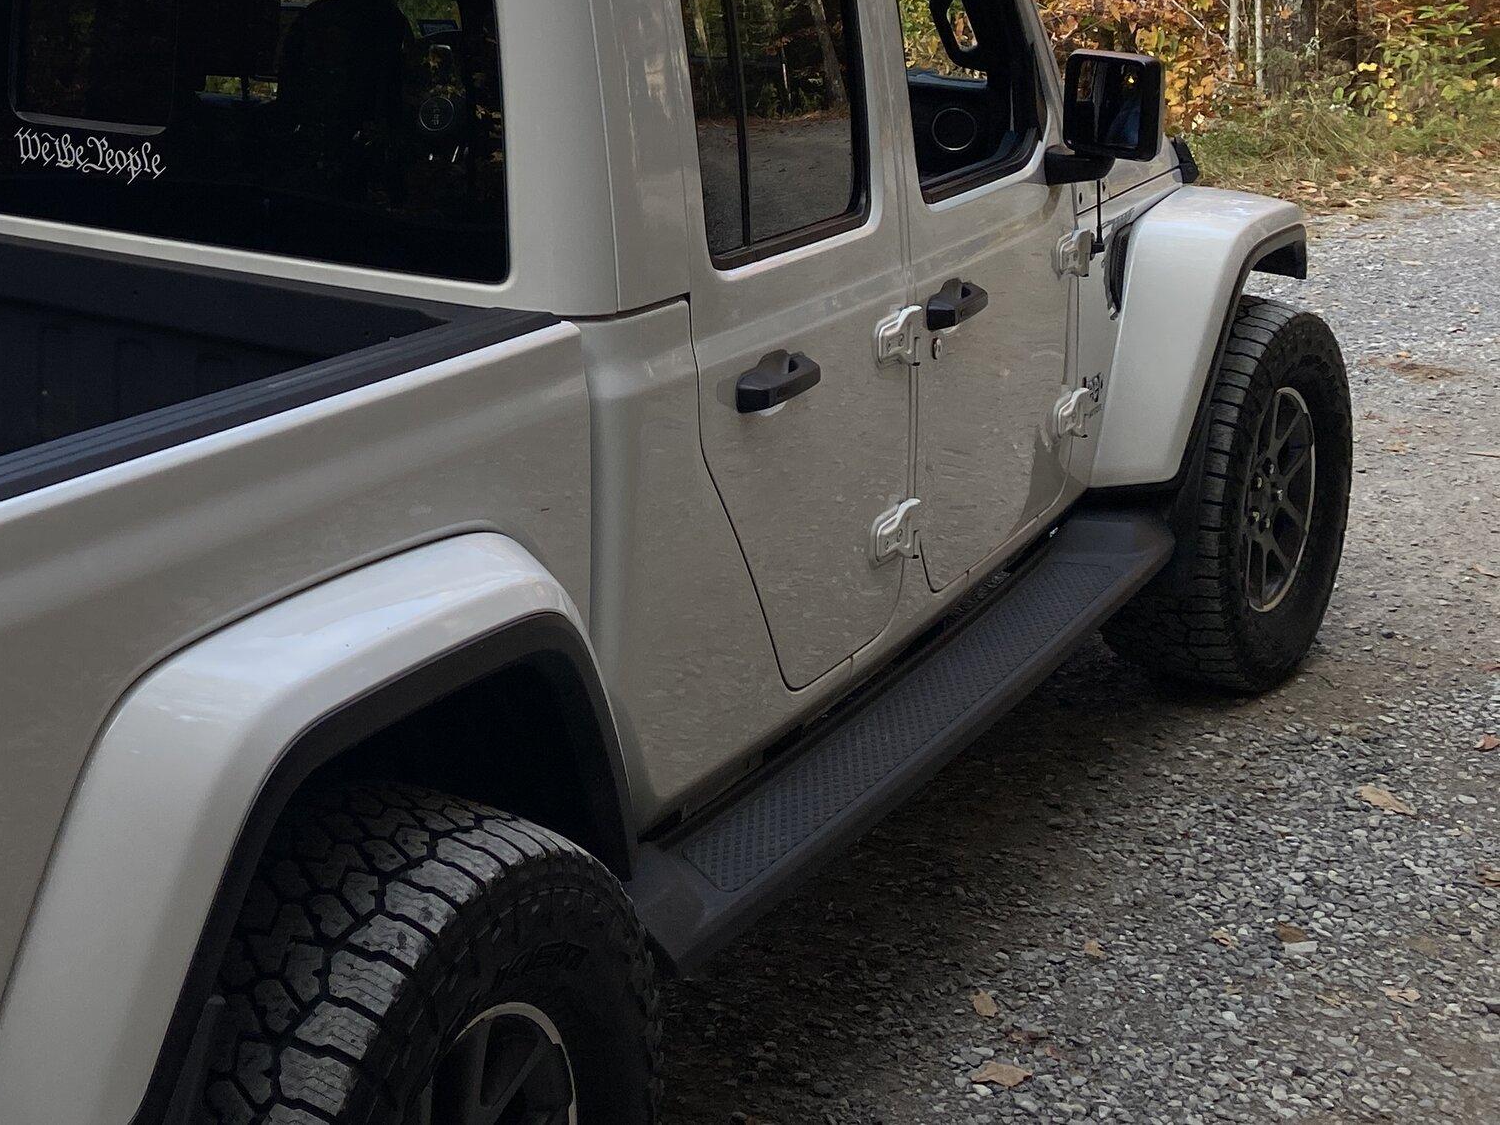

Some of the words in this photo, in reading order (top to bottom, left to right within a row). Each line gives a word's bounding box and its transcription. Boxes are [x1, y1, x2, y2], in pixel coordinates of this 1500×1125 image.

[14, 127, 55, 166] We
[54, 134, 89, 169] the
[82, 136, 167, 185] People
